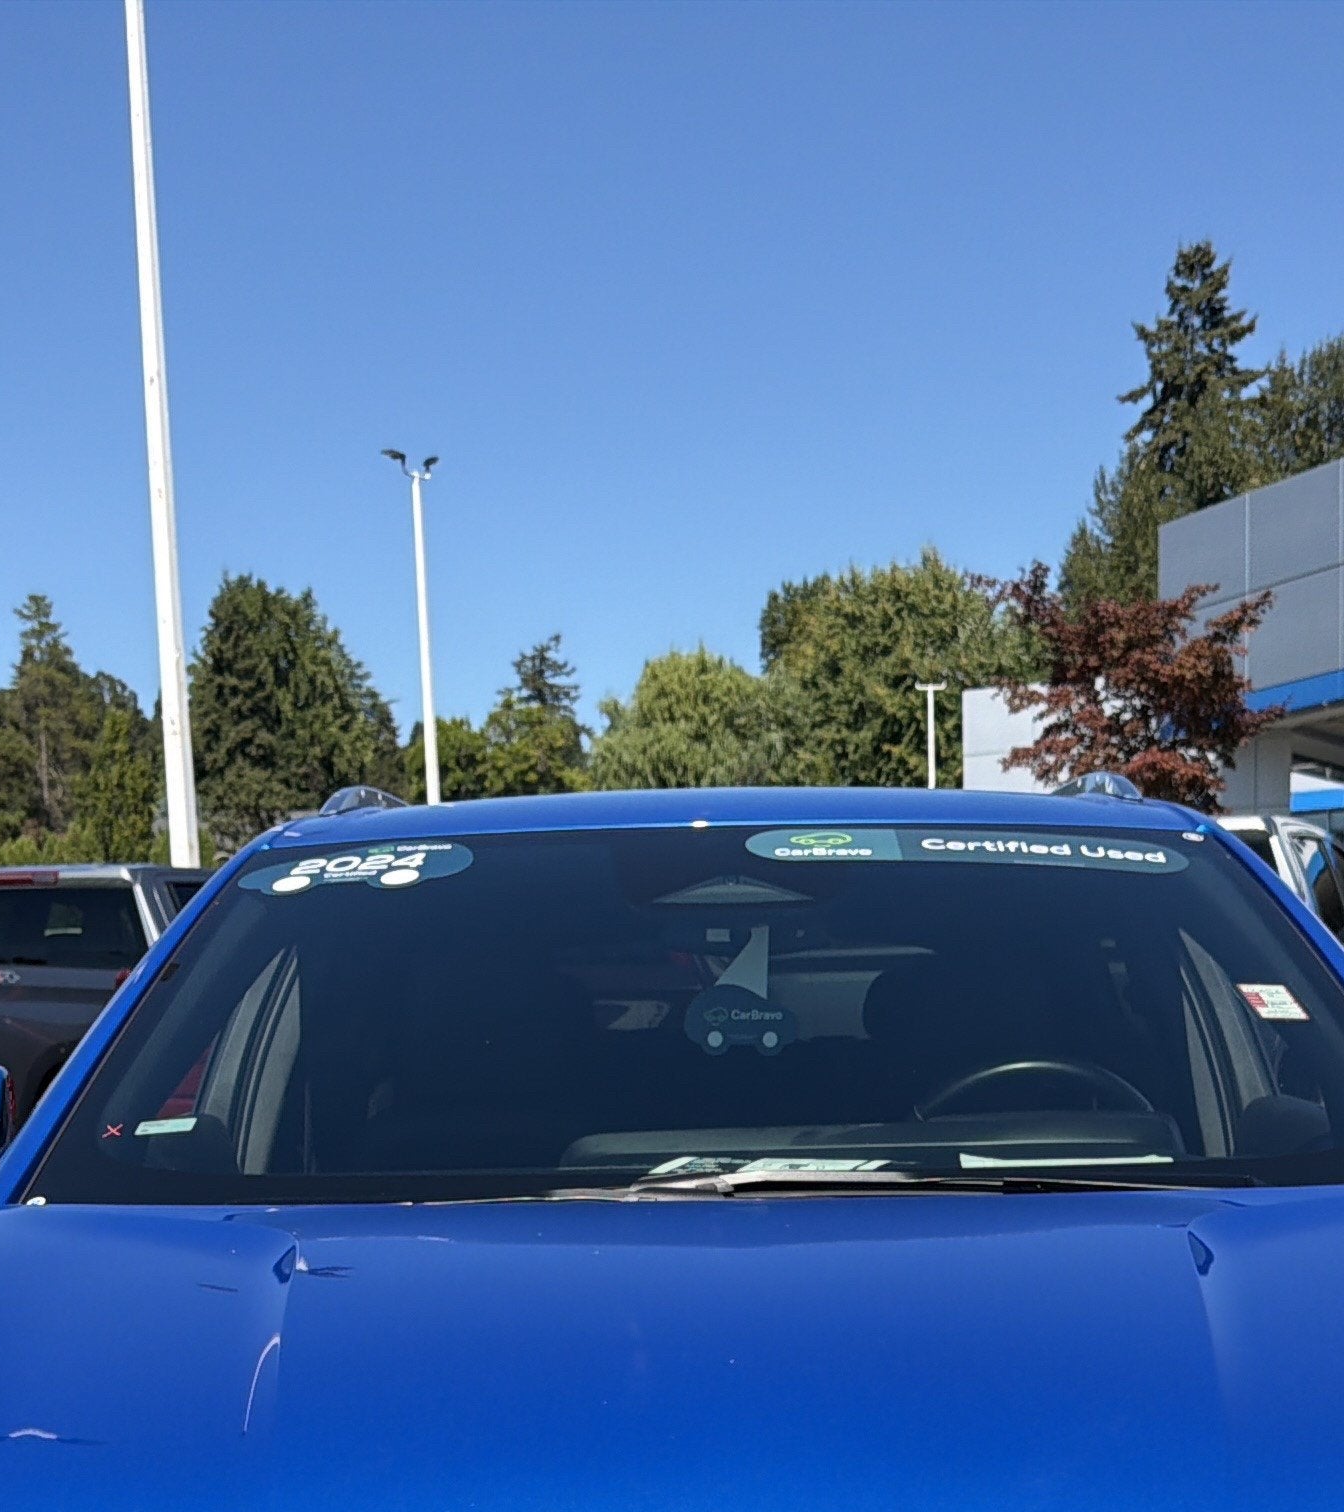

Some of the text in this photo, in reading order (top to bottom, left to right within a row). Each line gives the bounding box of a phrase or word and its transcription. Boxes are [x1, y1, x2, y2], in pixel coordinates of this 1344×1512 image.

[774, 847, 872, 857] CarBravo
[921, 838, 1167, 864] Certified Used
[290, 852, 426, 875] 2024
[731, 1009, 783, 1020] CarBravo
